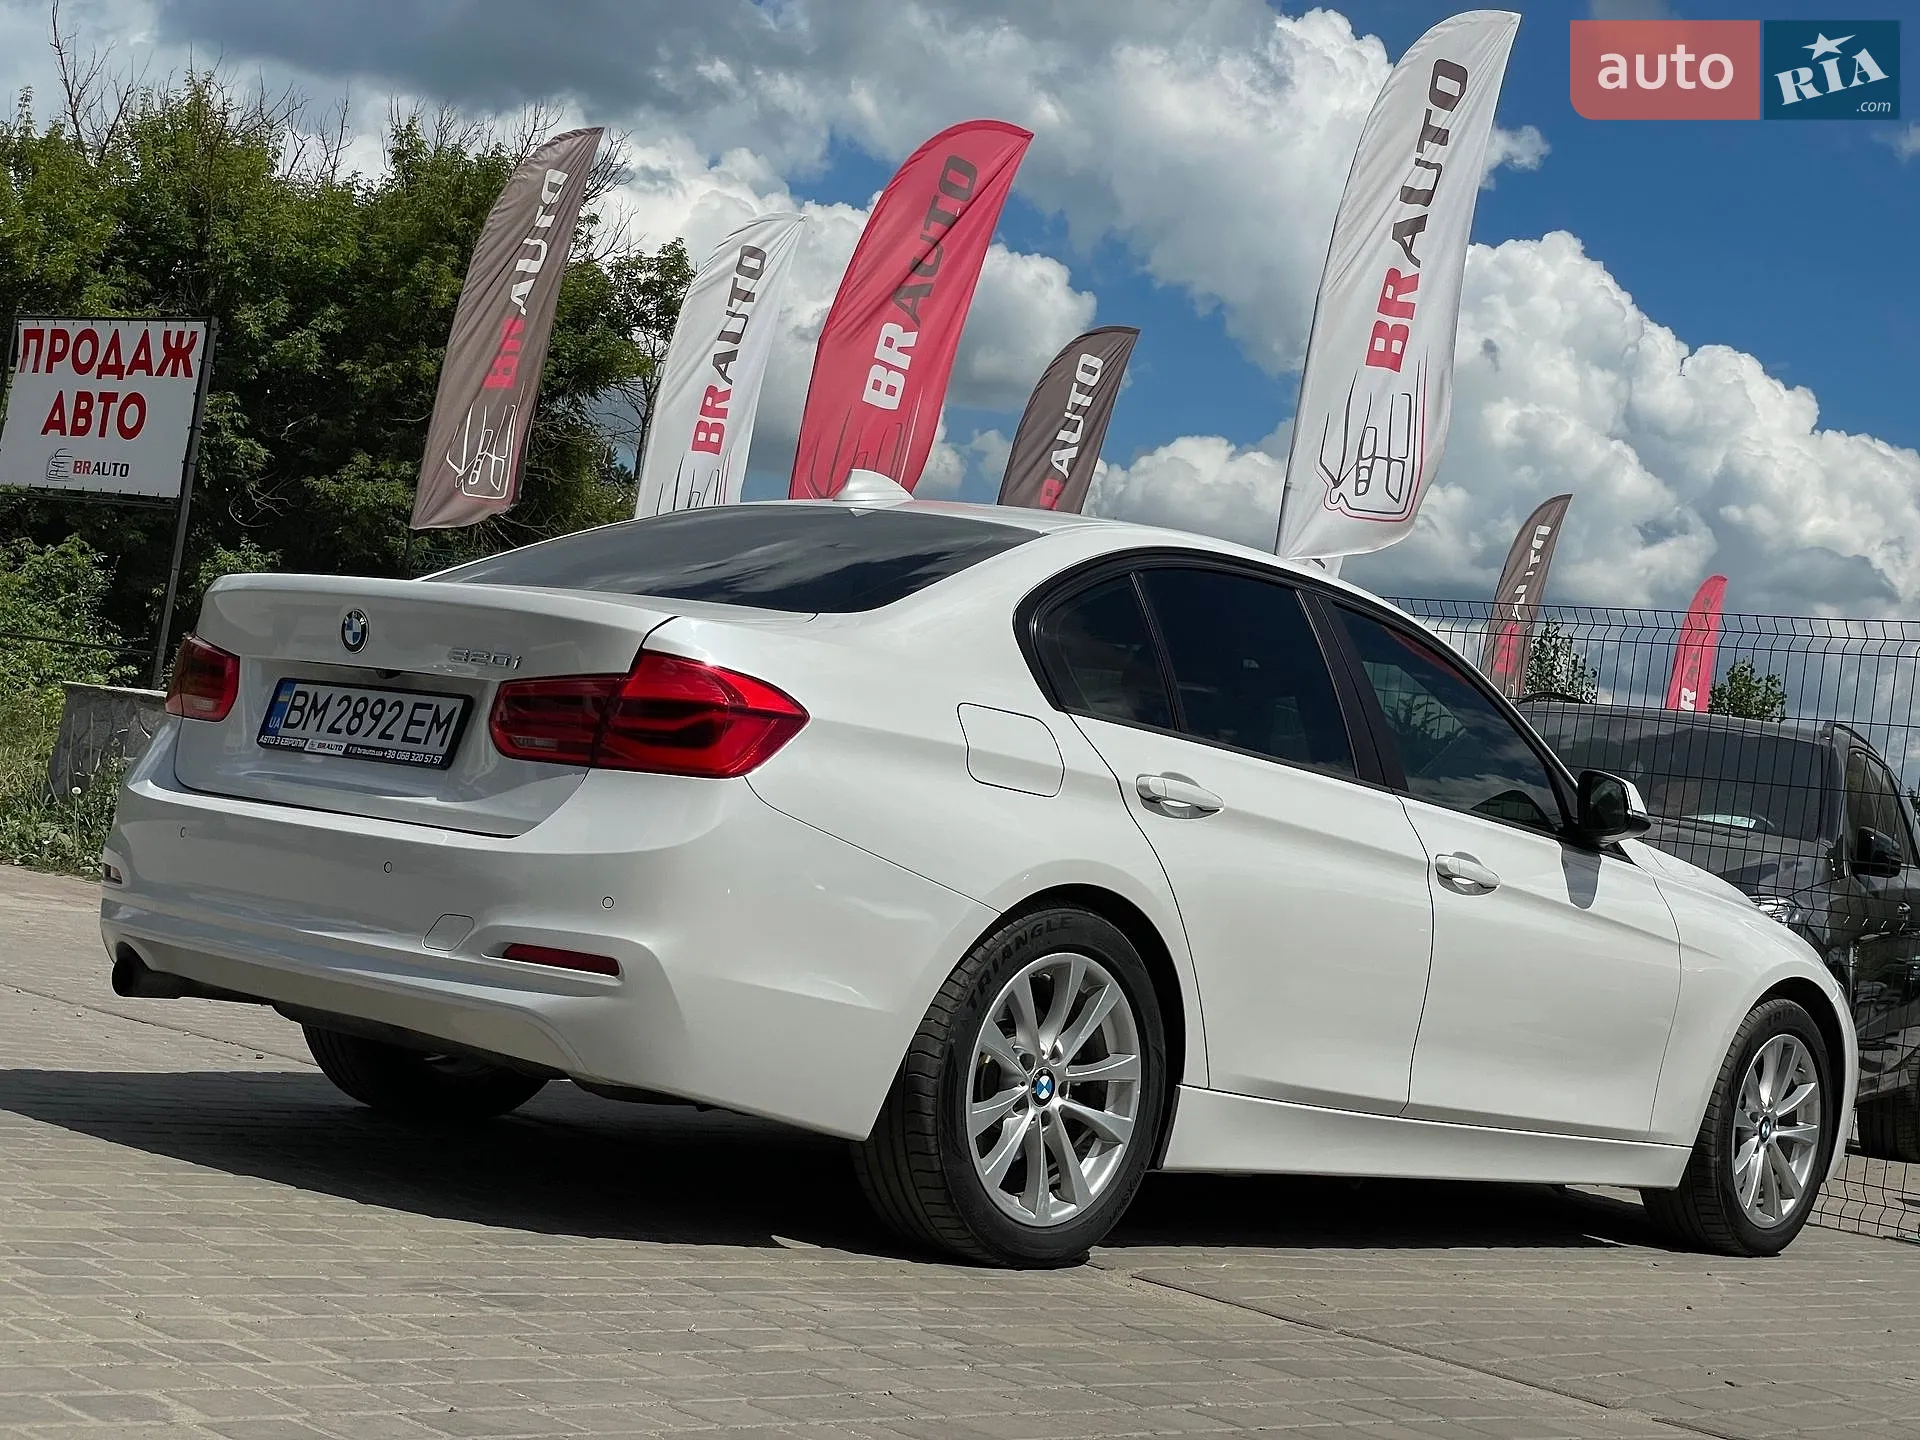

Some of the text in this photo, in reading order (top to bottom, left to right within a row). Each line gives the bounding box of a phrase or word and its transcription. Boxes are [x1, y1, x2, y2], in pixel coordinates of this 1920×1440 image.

[1365, 58, 1469, 373] BRAUTO
[862, 154, 979, 411] BRAUTO
[18, 327, 199, 381] ПРОДАЖ
[689, 244, 768, 456] BRAUTO
[40, 390, 148, 441] АВТО
[72, 460, 130, 478] BRAUTO
[268, 715, 282, 729] UA
[282, 689, 458, 748] BM 2892 EM
